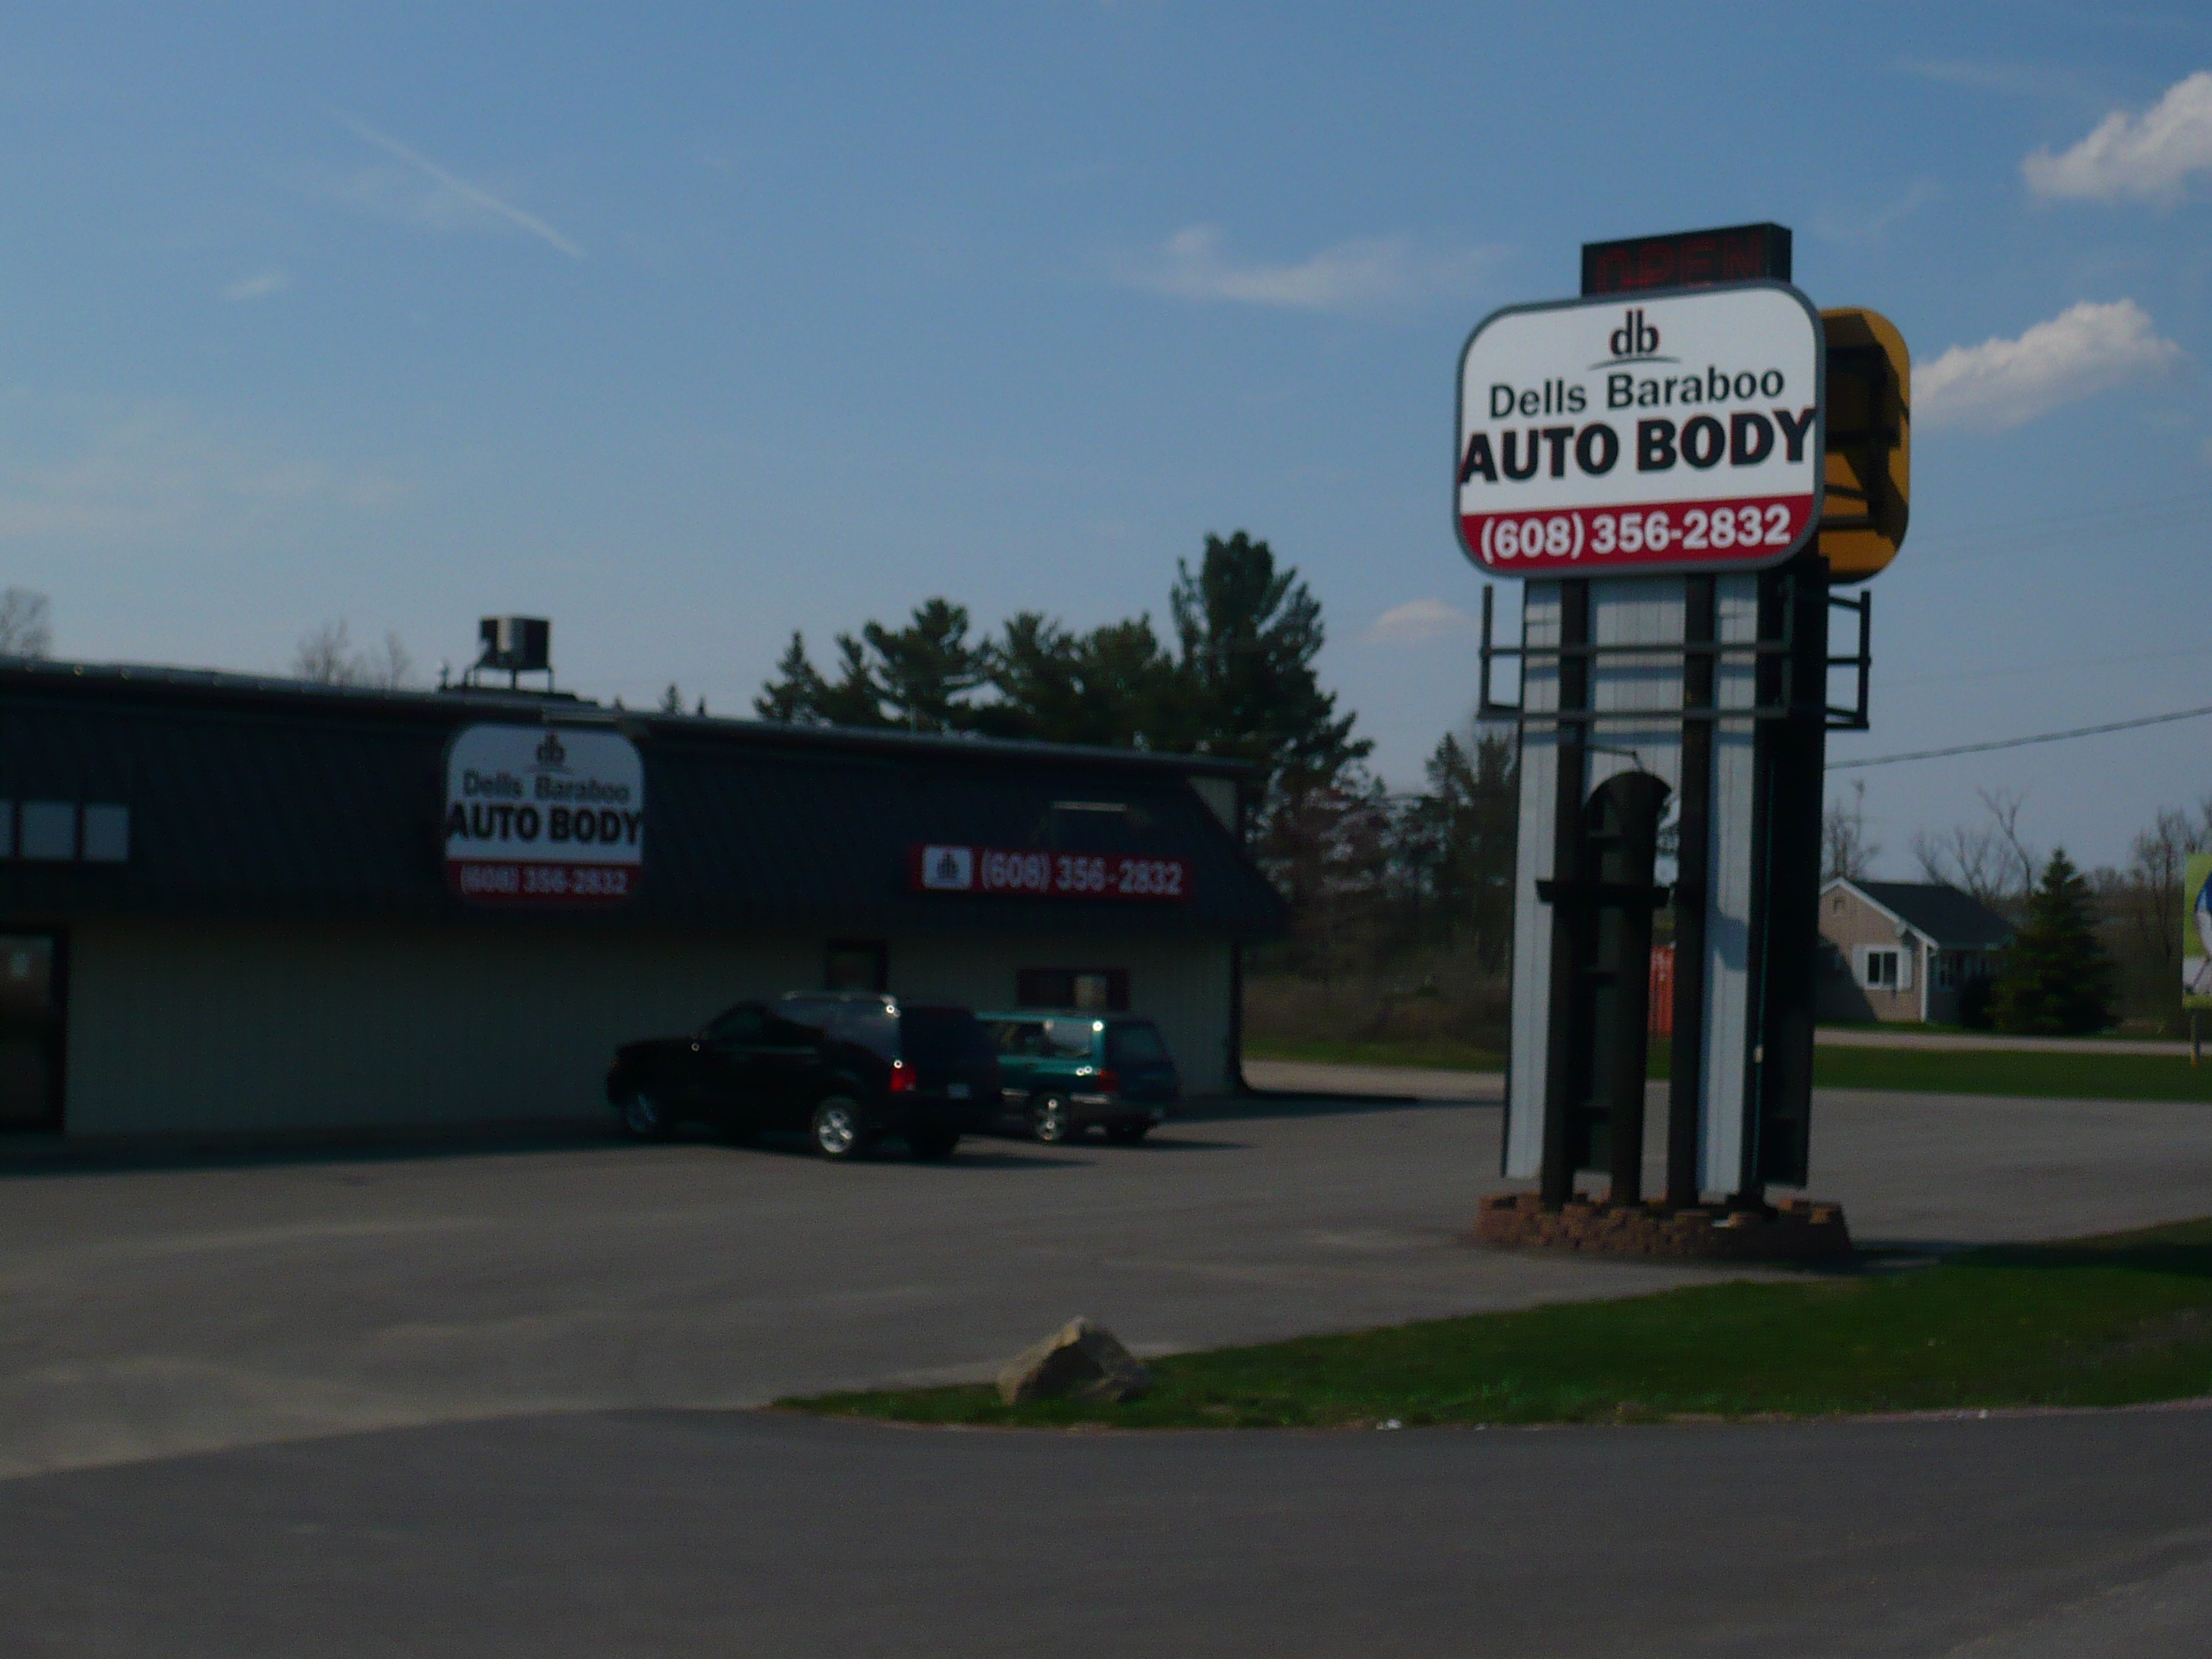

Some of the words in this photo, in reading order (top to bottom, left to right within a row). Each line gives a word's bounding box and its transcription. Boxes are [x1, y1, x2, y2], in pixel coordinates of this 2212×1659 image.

[1610, 309, 1660, 356] db
[1489, 379, 1588, 420] Dells
[1606, 366, 1785, 410] Baraboo
[1459, 422, 1620, 485] AUTO
[1637, 408, 1817, 474] BODY
[1480, 512, 1583, 565] (608)
[1591, 504, 1791, 554] 356-2832
[446, 801, 540, 842] AUTO
[549, 804, 644, 846] BODY
